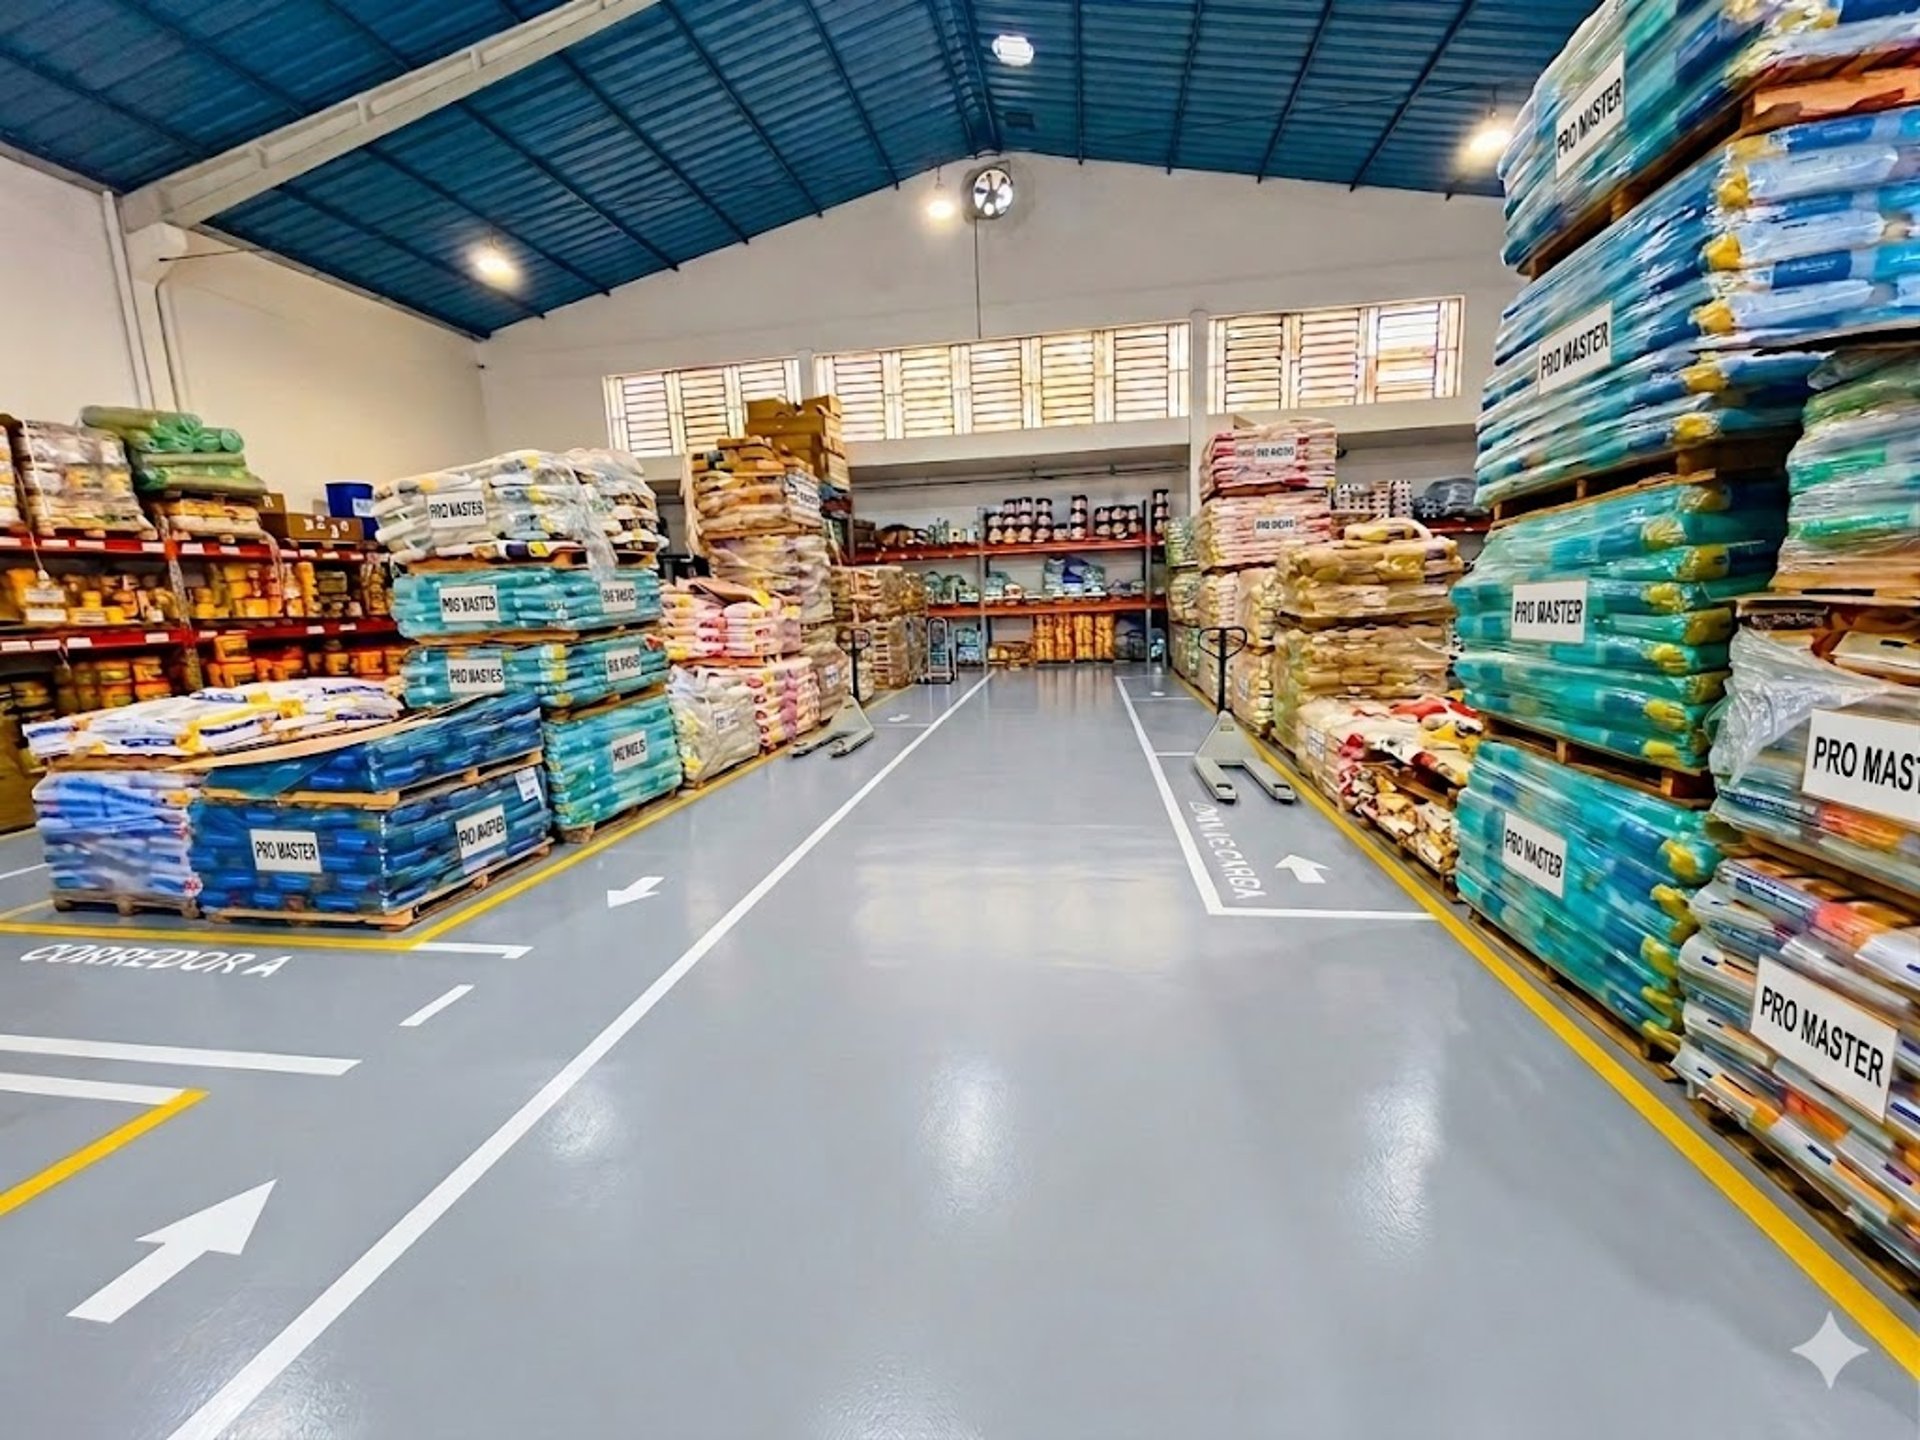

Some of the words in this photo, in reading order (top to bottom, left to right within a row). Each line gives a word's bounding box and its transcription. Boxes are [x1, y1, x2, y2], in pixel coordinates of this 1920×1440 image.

[1813, 736, 1857, 778] PRO
[20, 943, 256, 974] CORREDOR
[242, 955, 293, 978] A
[1760, 985, 1798, 1032] PRO
[1801, 1008, 1884, 1088] MASTER
